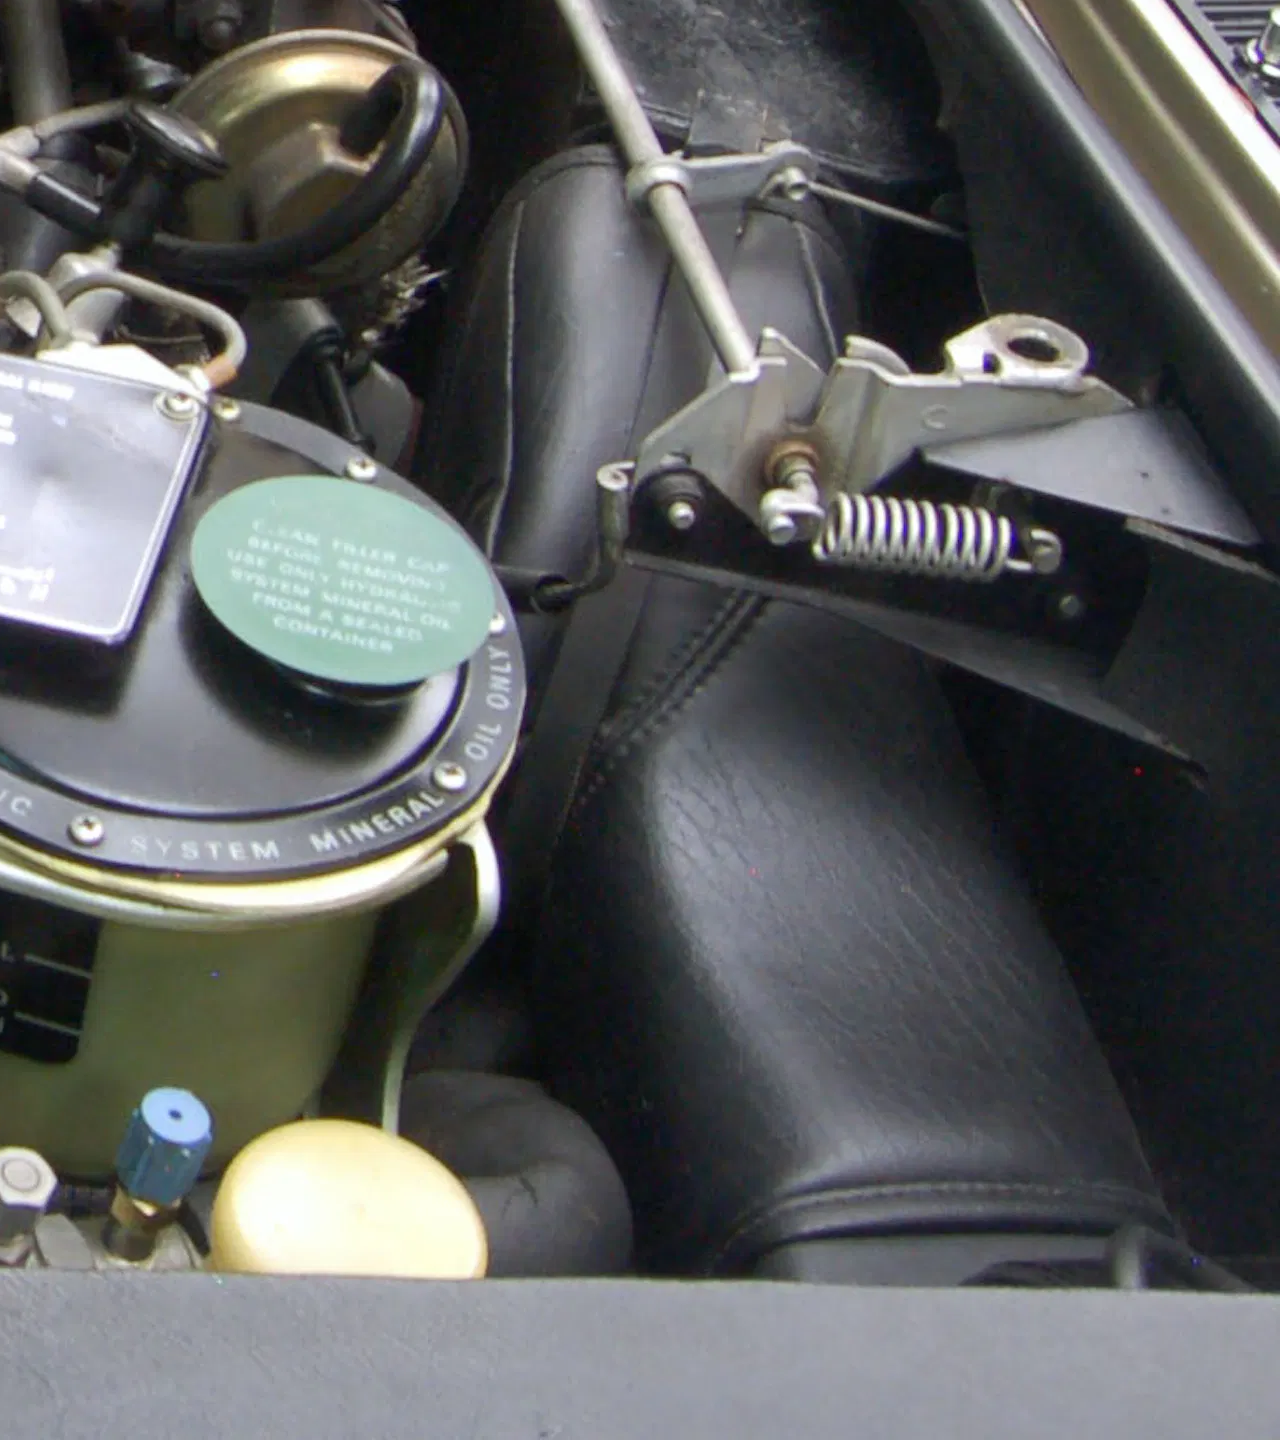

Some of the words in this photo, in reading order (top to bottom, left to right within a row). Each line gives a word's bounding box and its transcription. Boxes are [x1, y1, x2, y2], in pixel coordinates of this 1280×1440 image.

[227, 548, 268, 568] USE
[278, 562, 331, 583] ONLY
[247, 535, 321, 564] BEFORE
[332, 538, 397, 563] FILLER
[229, 567, 311, 598] SYSTEM
[322, 591, 414, 623] MINERAL
[419, 612, 452, 632] OIL
[252, 591, 311, 617] FROM
[340, 612, 424, 642] SEALED
[273, 614, 394, 654] CONTAINER
[130, 834, 280, 860] SYSTEM
[308, 789, 446, 854] MINERAL
[464, 722, 503, 761] OIL
[486, 647, 511, 711] ONLY
